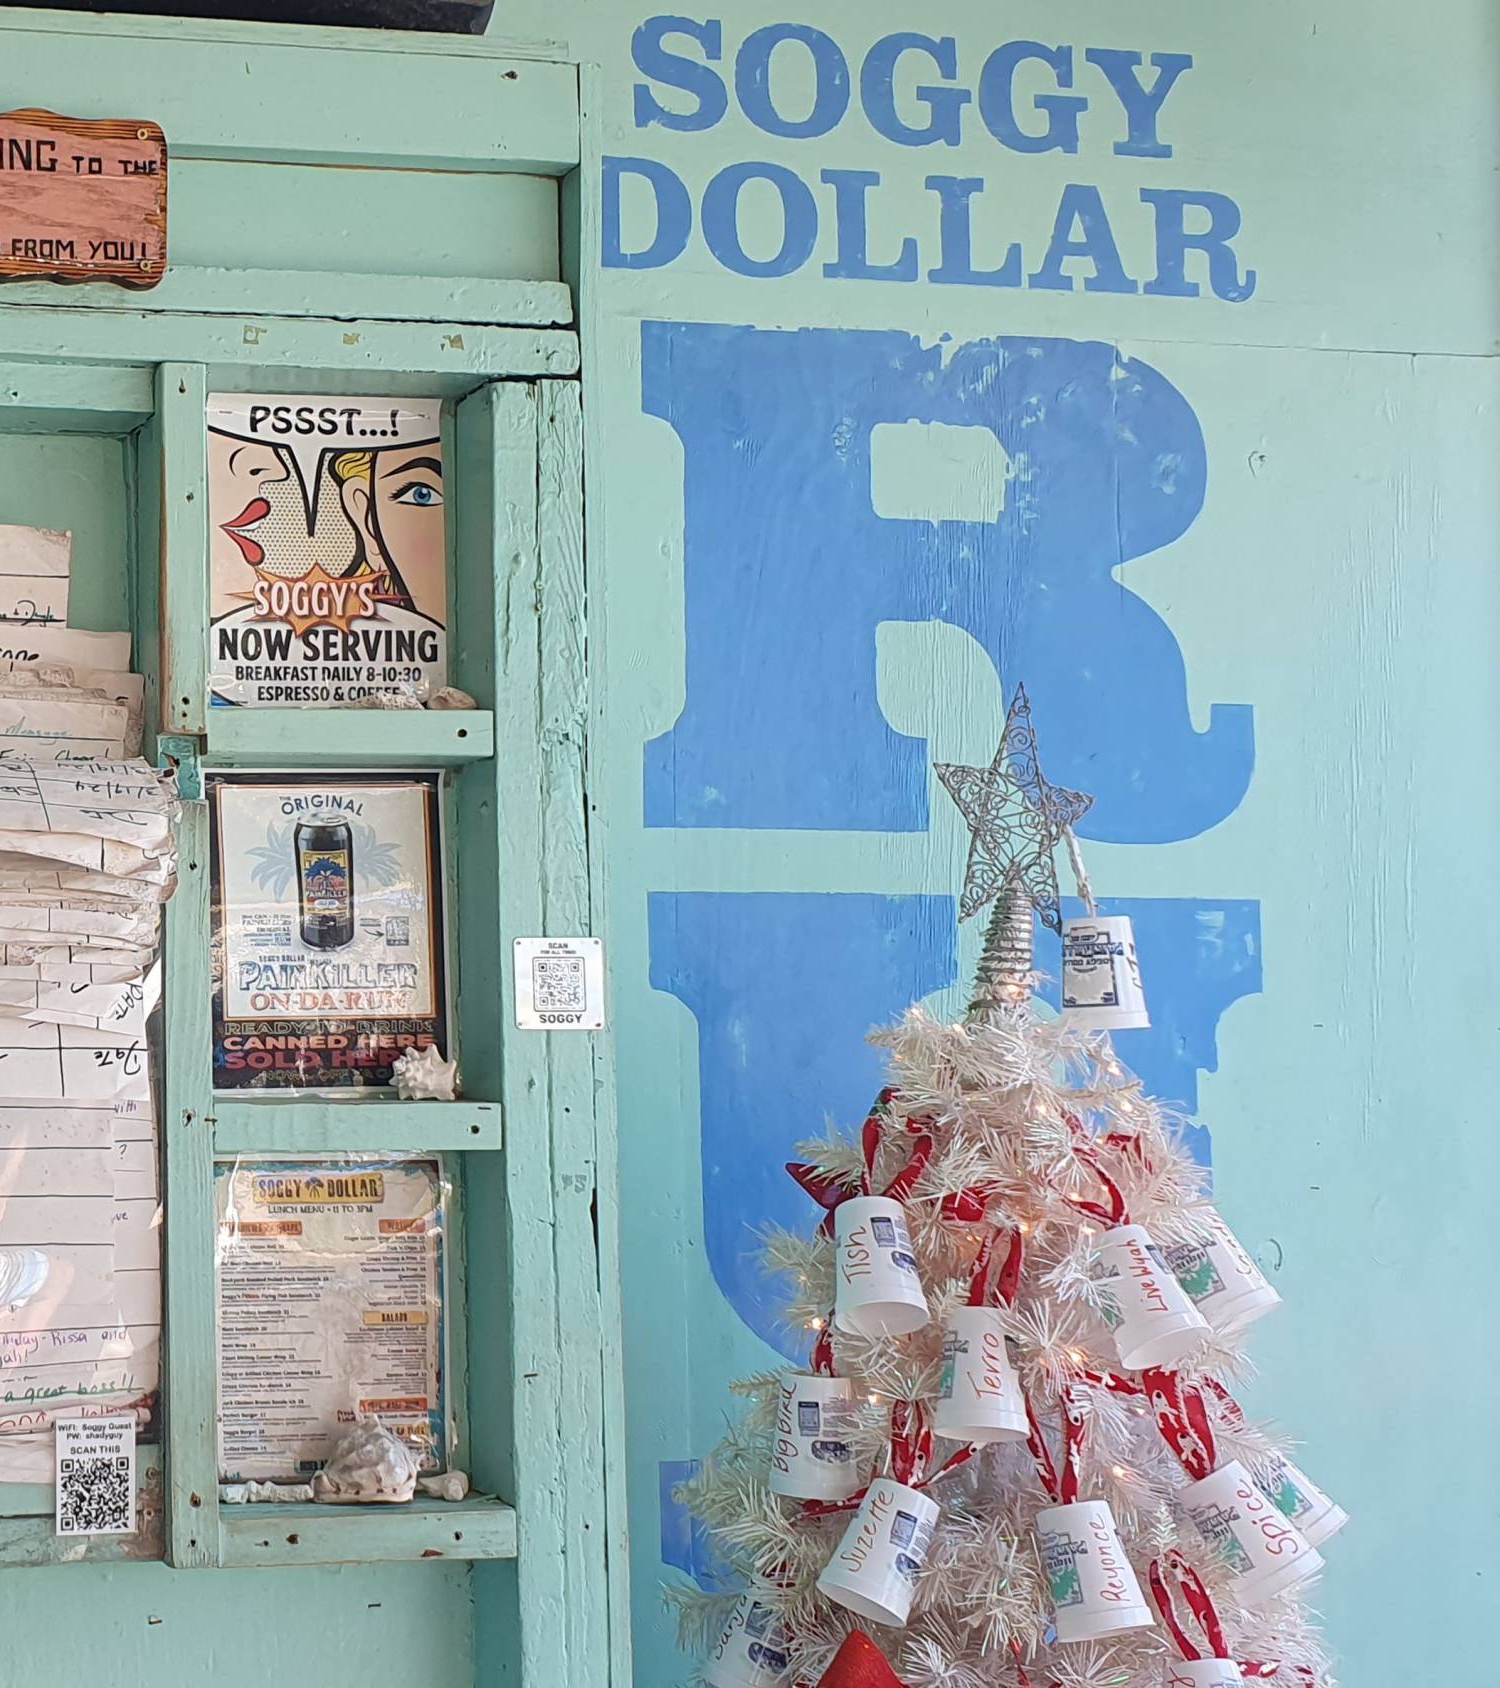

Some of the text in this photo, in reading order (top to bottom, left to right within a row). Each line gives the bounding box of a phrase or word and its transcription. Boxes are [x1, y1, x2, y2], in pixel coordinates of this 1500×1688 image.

[630, 15, 1193, 158] SOGGY
[71, 155, 102, 176] TO
[116, 156, 160, 177] THE
[601, 155, 1256, 304] DOLLAR
[11, 239, 74, 260] FROM
[252, 581, 377, 617] SOGGY'S
[218, 628, 438, 663] NOW SERVING
[235, 666, 421, 682] BREAKFAST DAILY 8-10:30
[257, 686, 344, 701] ESPRESSO &
[280, 794, 364, 817] ORIGINAL
[239, 962, 419, 991] PAINKILLER
[539, 1014, 583, 1024] SOGGY
[223, 1033, 437, 1050] CANNED HERE
[225, 1051, 321, 1070] SOLD
[258, 1178, 378, 1198] SOGGY DOLLAR
[268, 1206, 298, 1214] LUNCH
[300, 1205, 325, 1213] MENU
[842, 1226, 872, 1284] Tish
[24, 1385, 67, 1401] great
[70, 1445, 121, 1455] SCAN THIS
[1237, 1478, 1299, 1558] Spice
